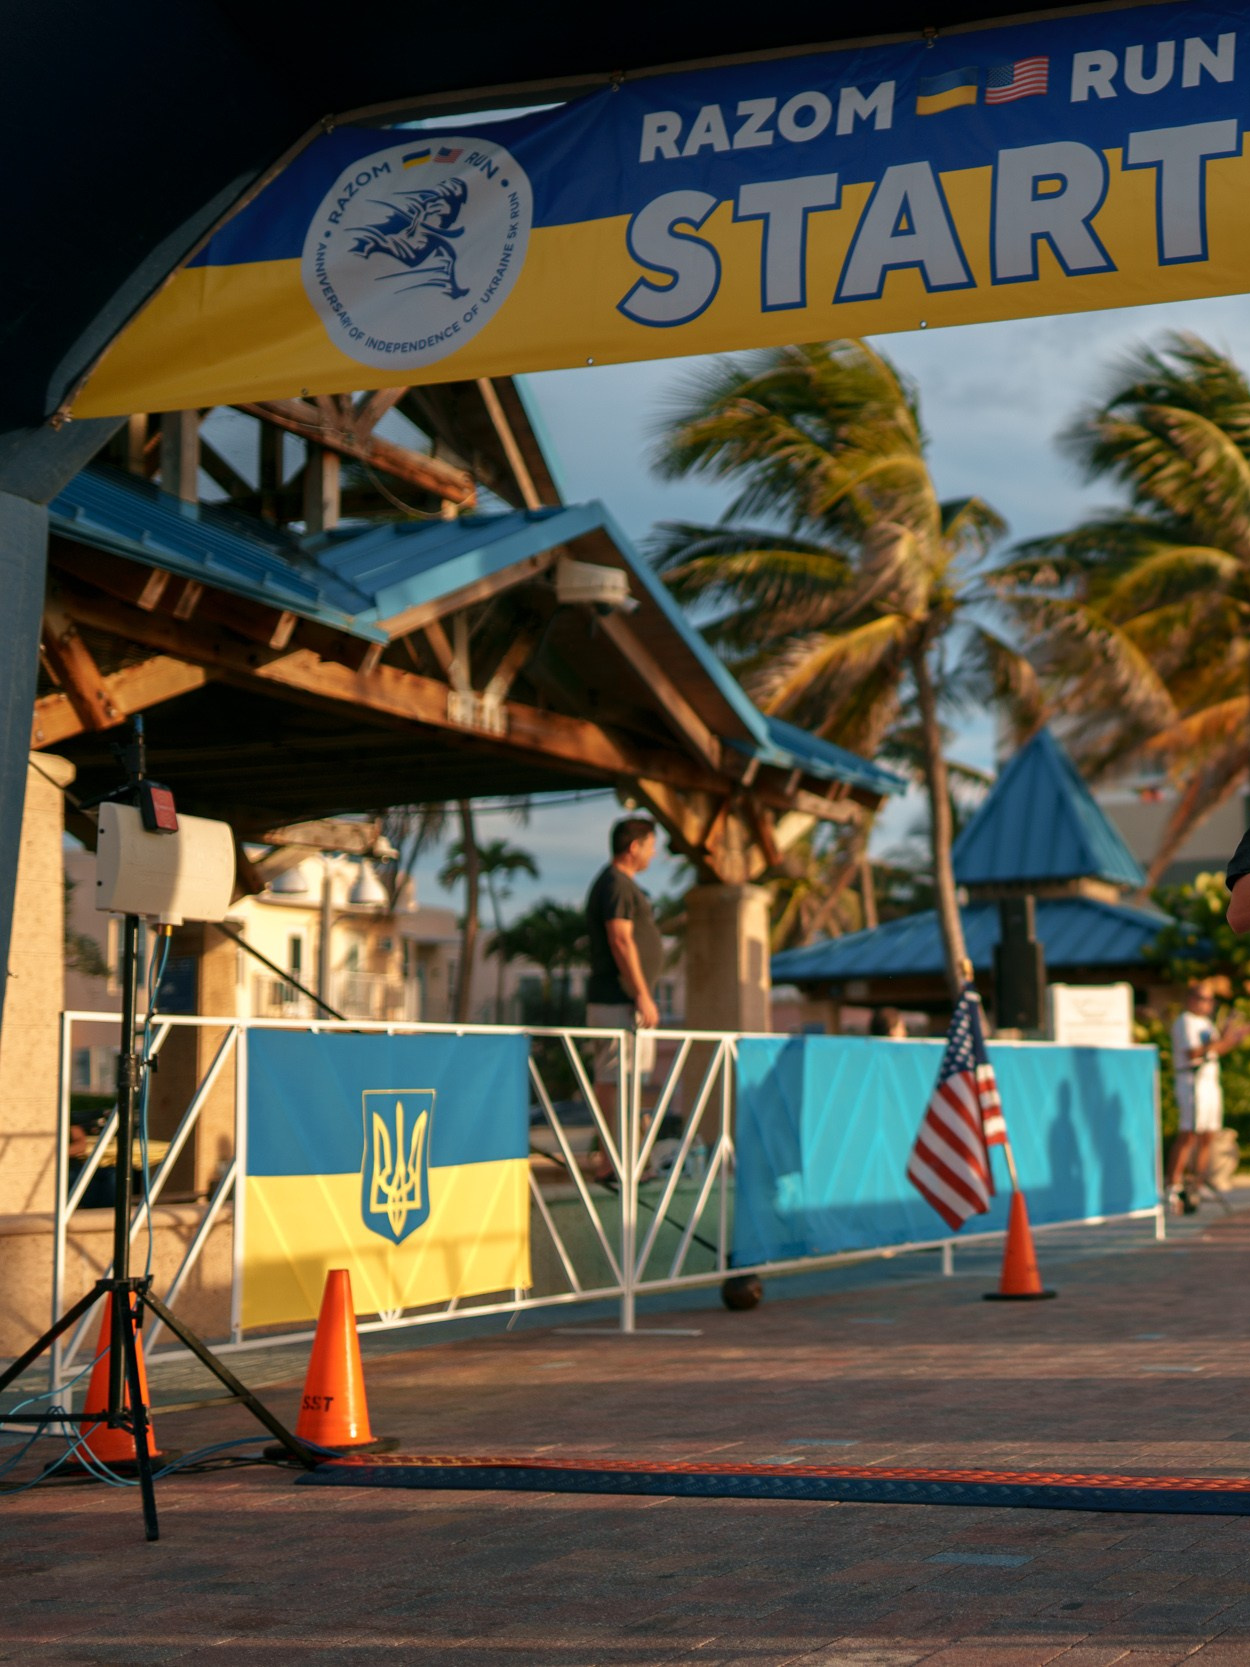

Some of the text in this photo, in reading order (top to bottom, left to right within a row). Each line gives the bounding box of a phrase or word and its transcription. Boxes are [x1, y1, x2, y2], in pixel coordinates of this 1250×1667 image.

[639, 32, 1237, 163] RAZOM RUN
[328, 151, 500, 225] RAZOM RUN
[615, 119, 1243, 328] START
[315, 191, 520, 353] ANNIVERSARY OF INDEPENDENCE OF UKRAINE 5K RUN
[302, 1395, 334, 1412] SST
